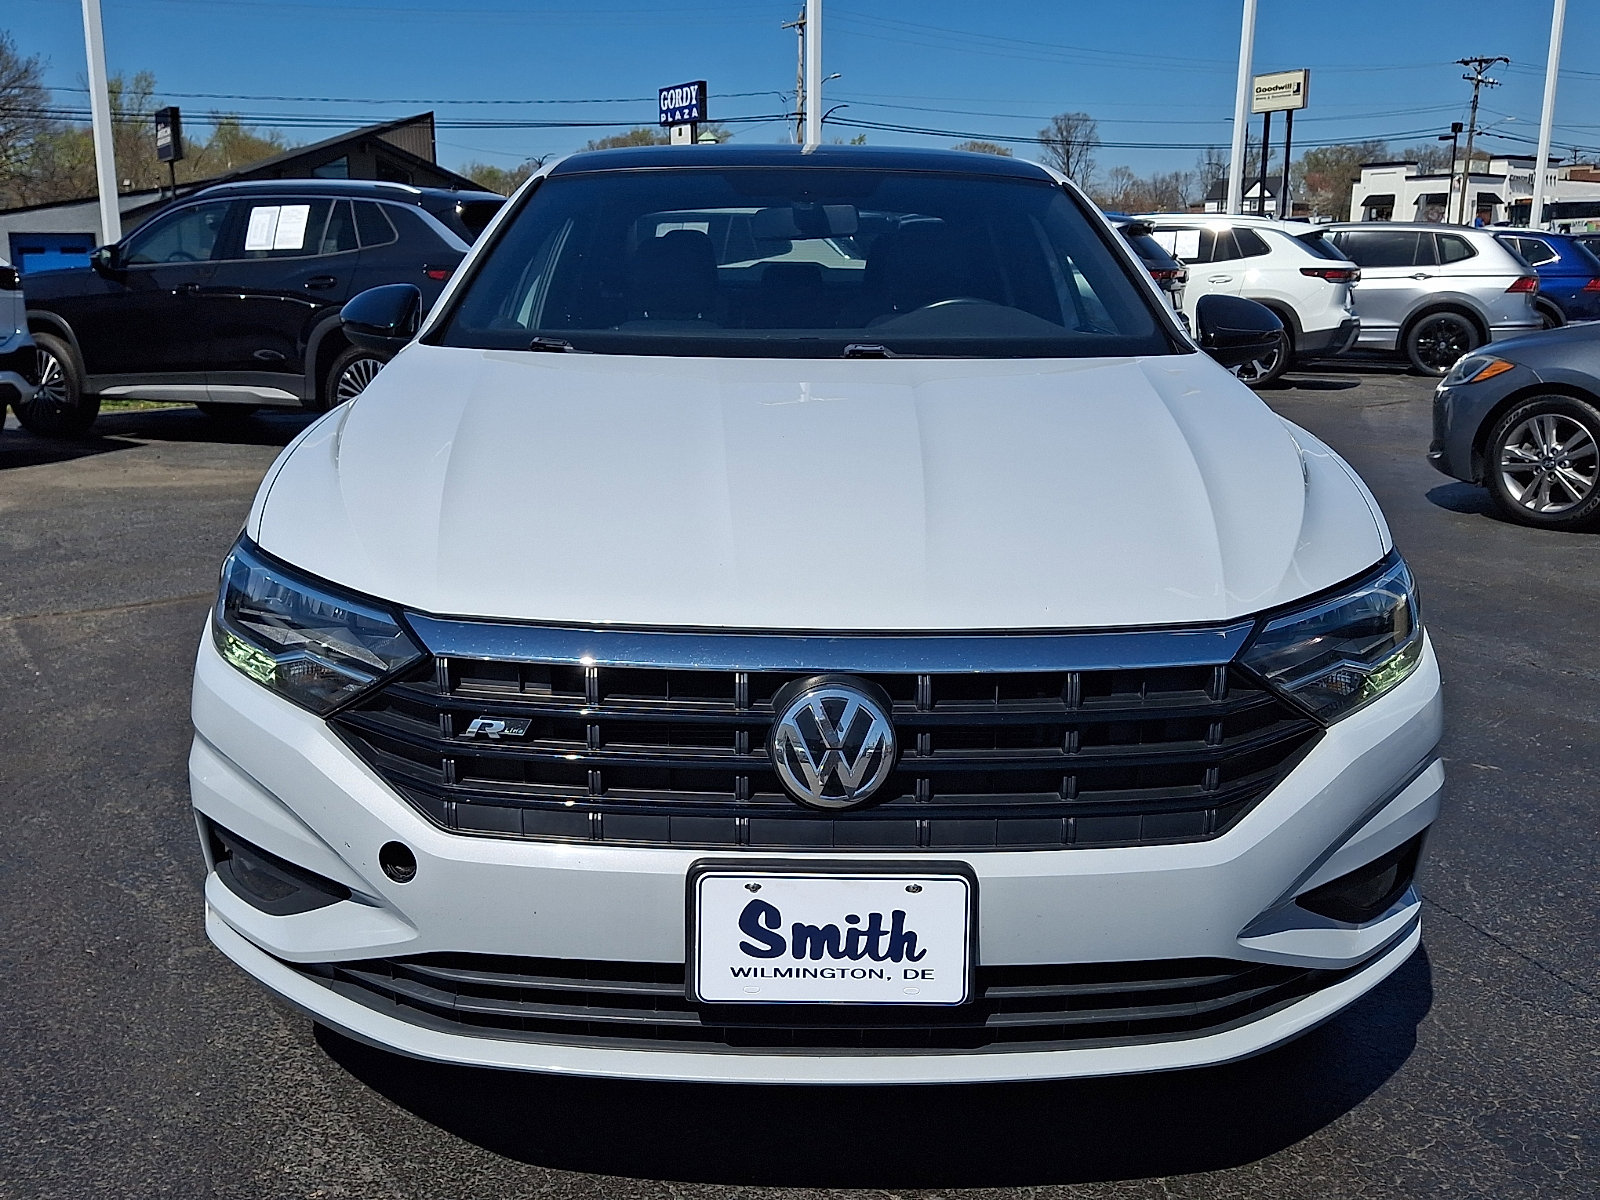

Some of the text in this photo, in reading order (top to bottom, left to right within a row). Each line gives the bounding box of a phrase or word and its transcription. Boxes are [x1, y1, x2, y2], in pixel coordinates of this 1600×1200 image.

[1255, 83, 1292, 93] Goodwill
[660, 85, 698, 111] GORDY
[660, 107, 699, 122] PLAZA
[459, 719, 505, 738] R
[738, 899, 928, 963] Smith
[729, 966, 936, 982] WILMINGTON, DE
